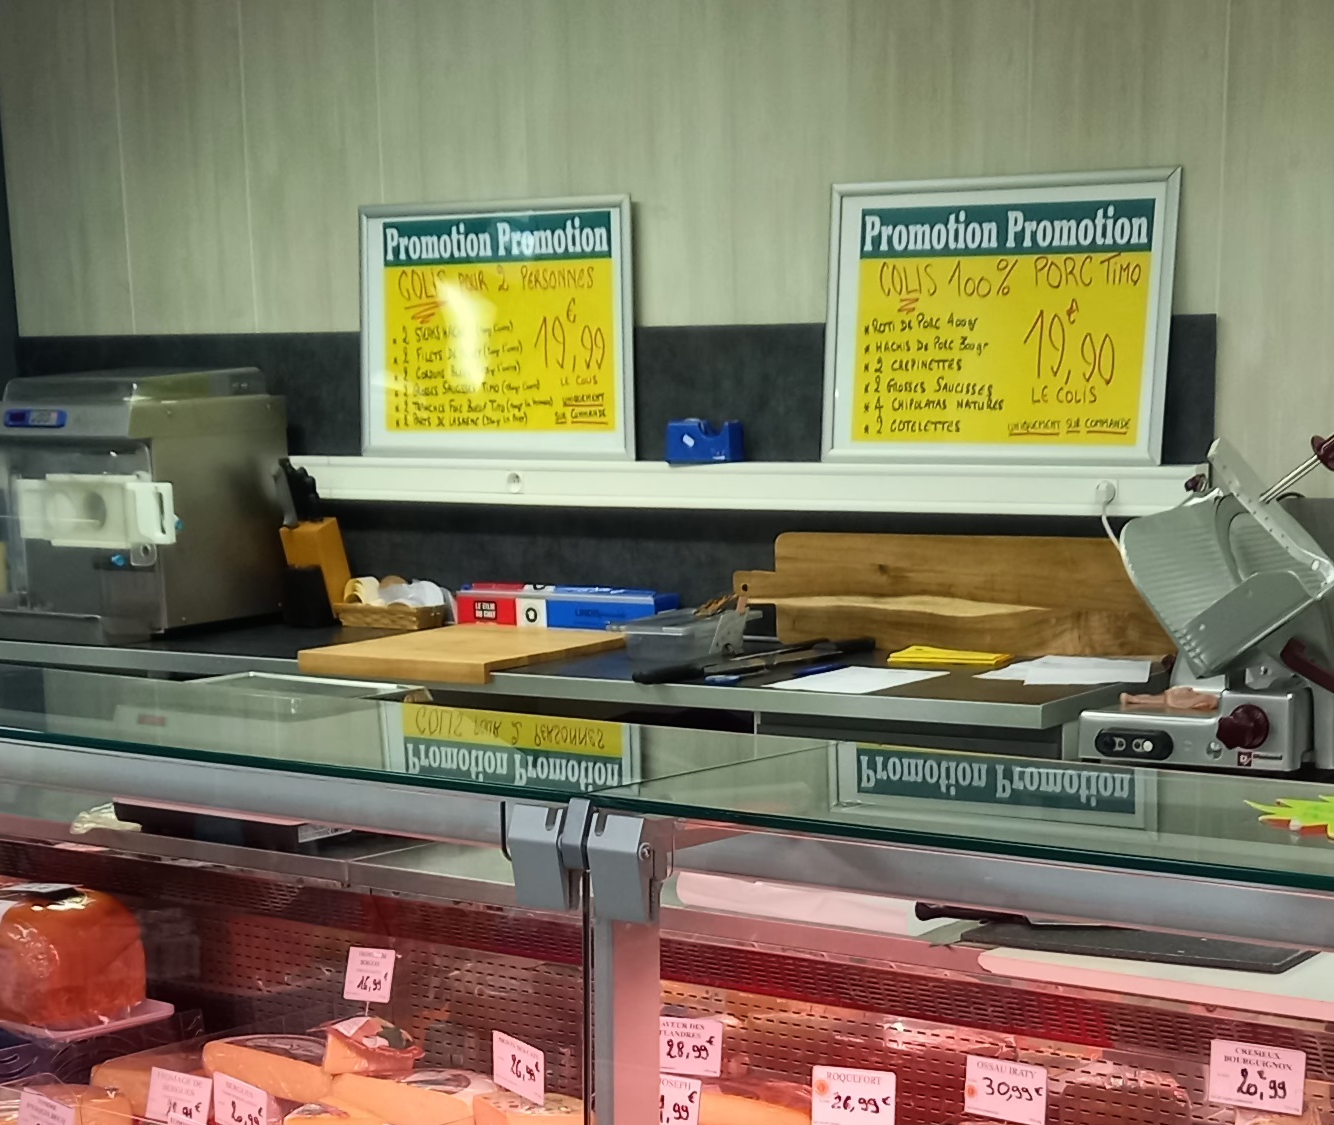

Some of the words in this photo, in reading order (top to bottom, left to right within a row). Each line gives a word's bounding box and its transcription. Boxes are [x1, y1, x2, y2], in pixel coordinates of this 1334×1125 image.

[386, 222, 492, 260] Promotion
[497, 216, 608, 256] Promotion
[864, 210, 997, 251] Promotion
[1006, 205, 1148, 249] Promotion
[498, 265, 508, 291] 2
[880, 262, 938, 297] COLIS
[1034, 256, 1093, 288] PORC
[1032, 387, 1047, 403] LE
[826, 1071, 882, 1086] ROQUEFORT
[977, 1061, 1007, 1073] OSSAU
[1009, 1067, 1036, 1079] IRATY
